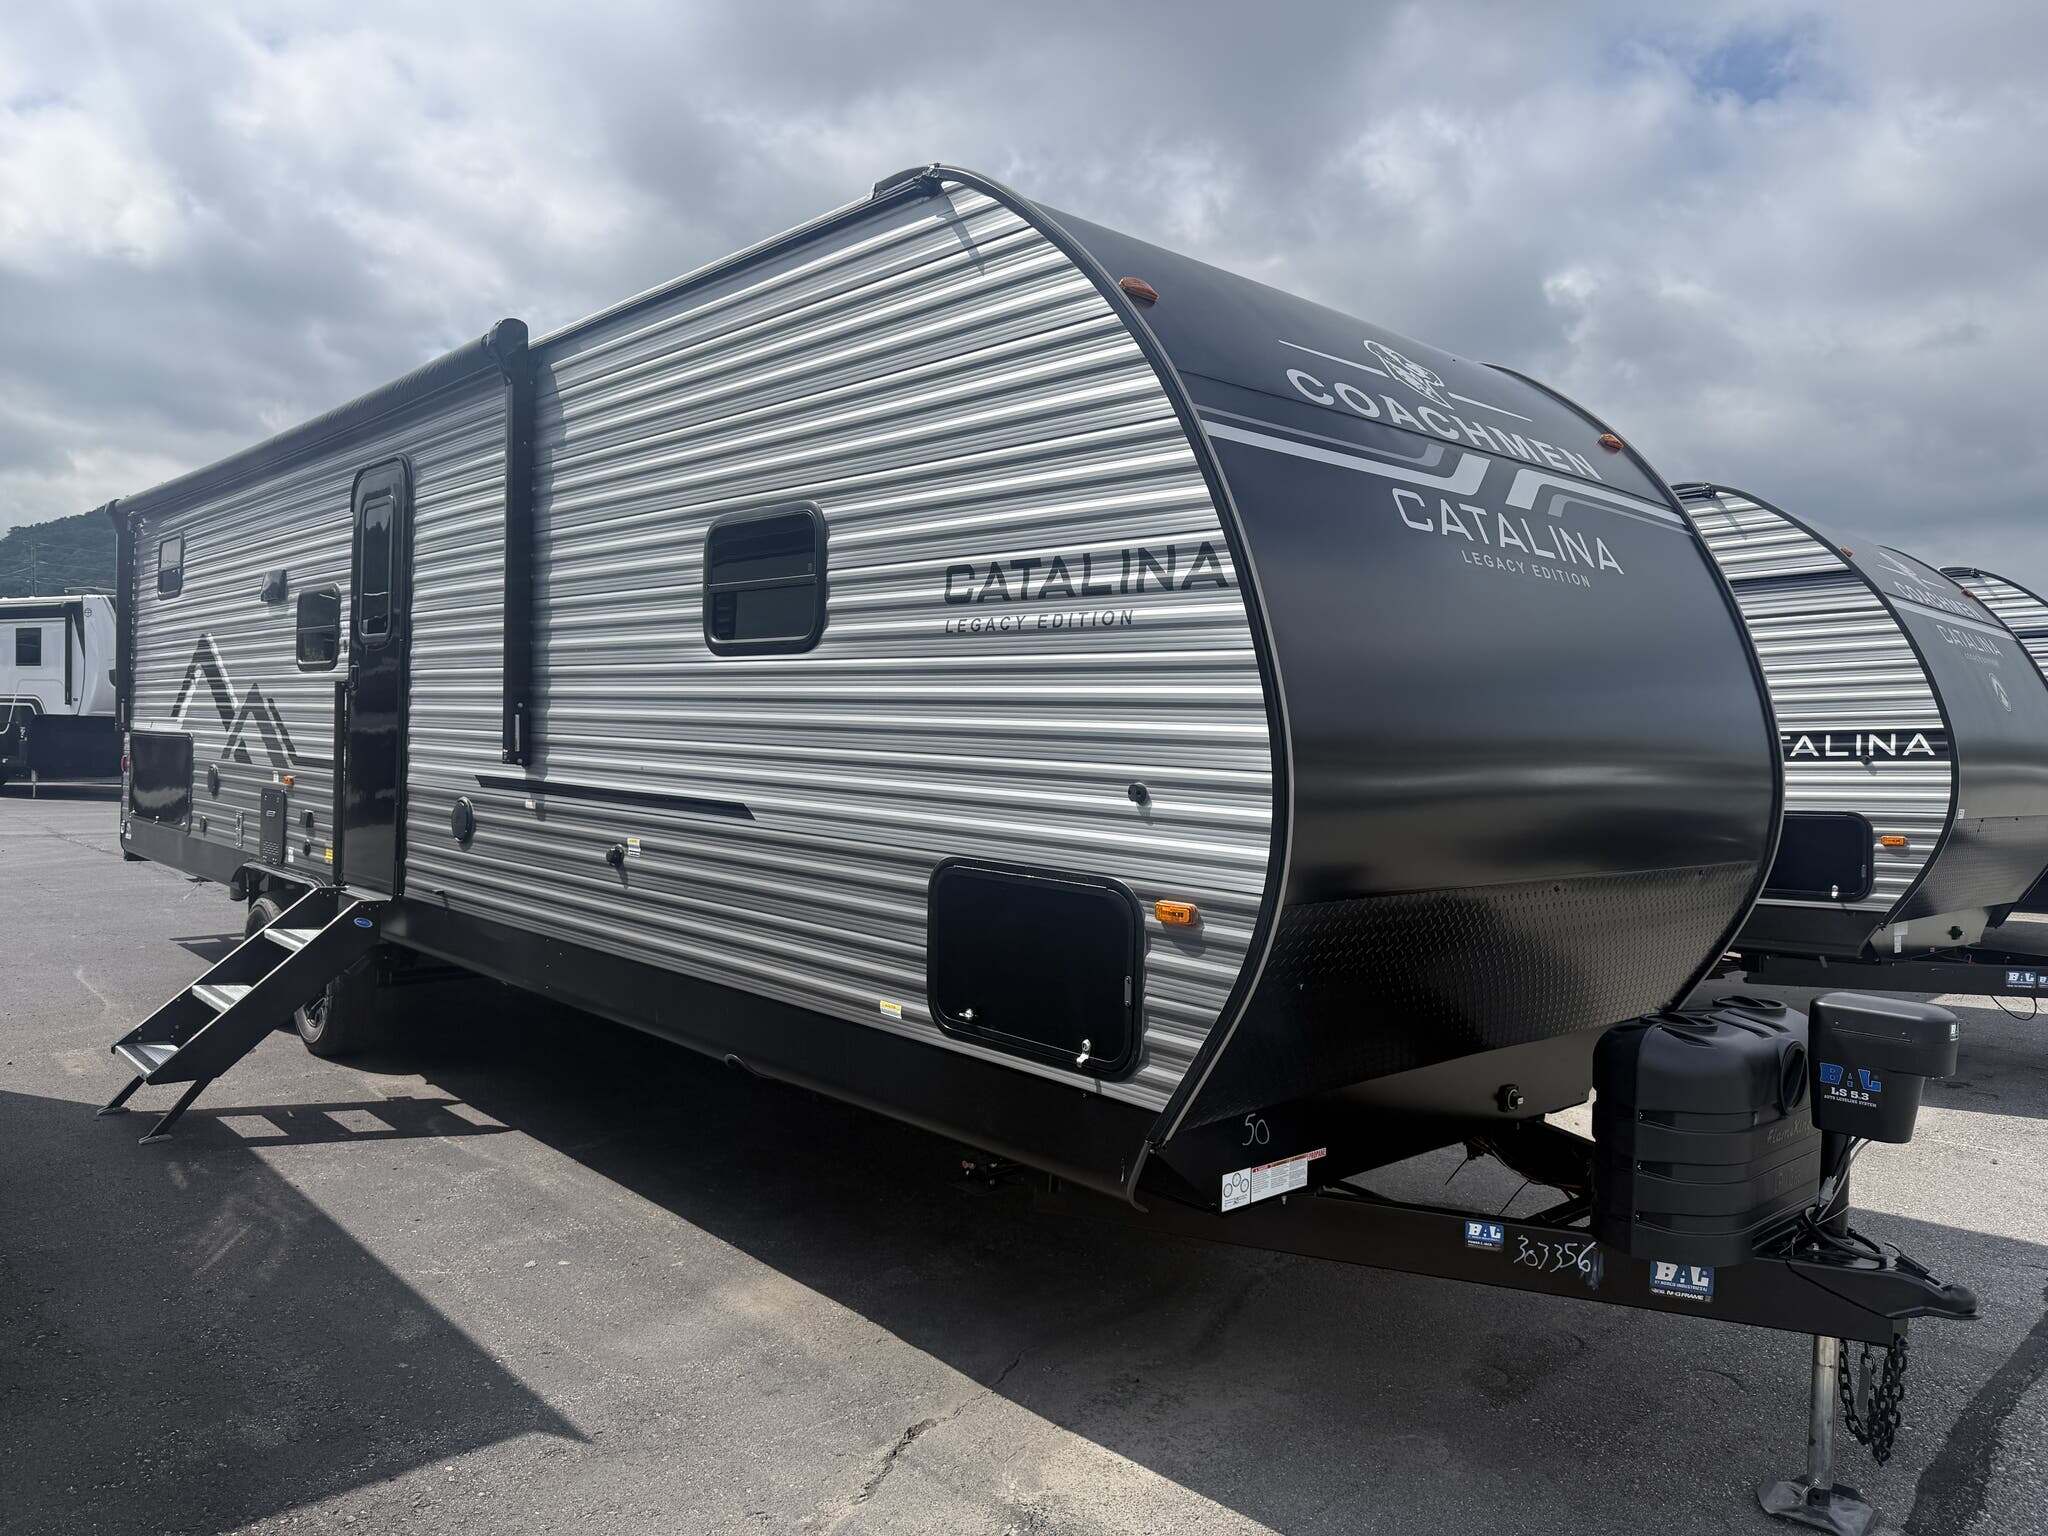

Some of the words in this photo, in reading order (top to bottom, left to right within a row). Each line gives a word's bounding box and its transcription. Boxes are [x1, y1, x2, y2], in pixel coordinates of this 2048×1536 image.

[1286, 368, 1602, 480] COACHMEN
[1391, 487, 1625, 575] CATALINA
[944, 540, 1230, 605] CATALINA
[1461, 550, 1524, 575] LEGACY
[1532, 564, 1592, 588] EDITION
[945, 615, 1027, 634] LEGACY
[1037, 609, 1134, 630] EDITION
[1936, 624, 2004, 657] CATALINA
[1780, 732, 1936, 757] ALINA
[1830, 1086, 1848, 1098] LS
[1850, 1090, 1870, 1101] 5.3
[1242, 1113, 1270, 1146] 50
[1468, 1222, 1502, 1239] BAL
[1655, 1260, 1710, 1287] BAL
